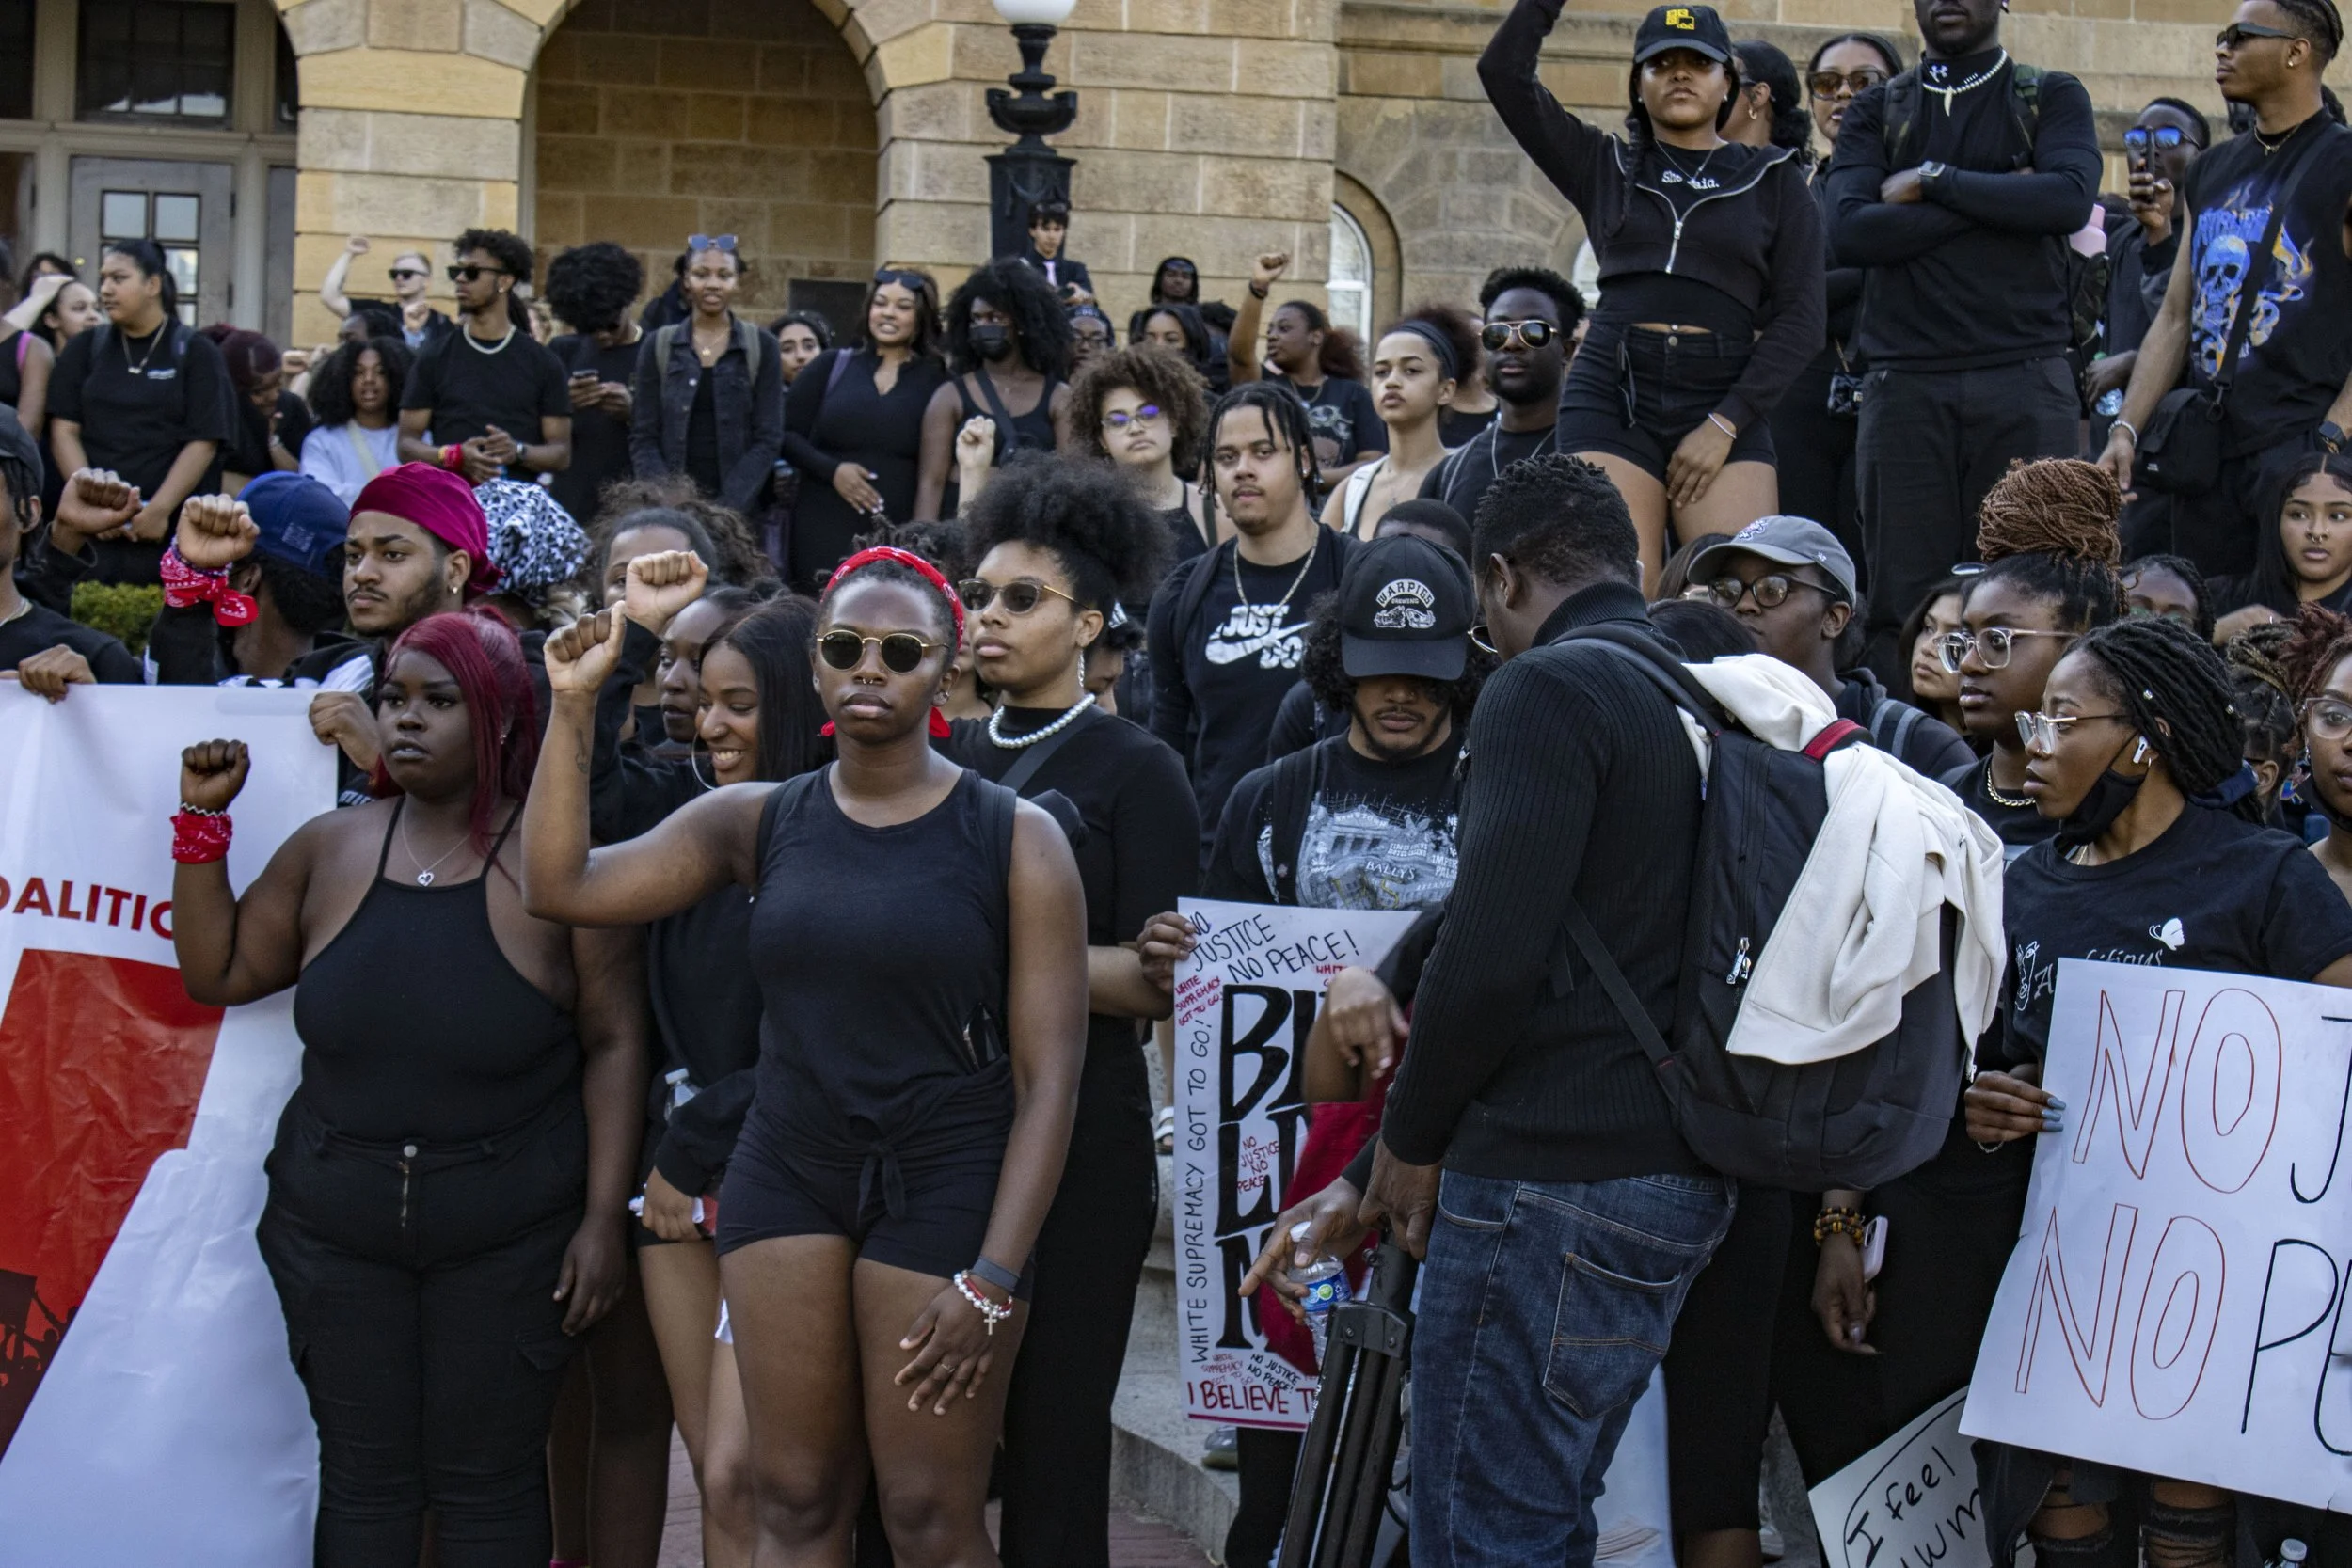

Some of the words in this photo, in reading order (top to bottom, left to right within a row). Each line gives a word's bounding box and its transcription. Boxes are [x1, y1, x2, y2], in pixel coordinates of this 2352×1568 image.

[1377, 580, 1434, 605] WARPIGS
[1366, 861, 1416, 880] BALLYS
[1189, 914, 1276, 972] JUSTICE
[1227, 956, 1264, 984] NO
[1265, 930, 1359, 974] PEACE!
[1178, 1010, 1193, 1026] GOT
[1191, 1019, 1212, 1058] GO!
[1189, 1069, 1207, 1100] TO
[2072, 988, 2282, 1195] NO
[1188, 1105, 1208, 1152] GOT
[1243, 1136, 1257, 1151] NO
[1241, 1140, 1279, 1168] JUSTICE
[1250, 1160, 1269, 1175] NO
[1184, 1162, 1207, 1290] SUPREMACY
[2014, 1202, 2226, 1421] NO
[1190, 1300, 1209, 1363] WHITE
[1247, 1364, 1262, 1378] NO
[1250, 1354, 1264, 1364] NO
[1264, 1359, 1302, 1386] JUSTICE
[1187, 1381, 1195, 1406] I
[1200, 1380, 1290, 1415] BELIEVE
